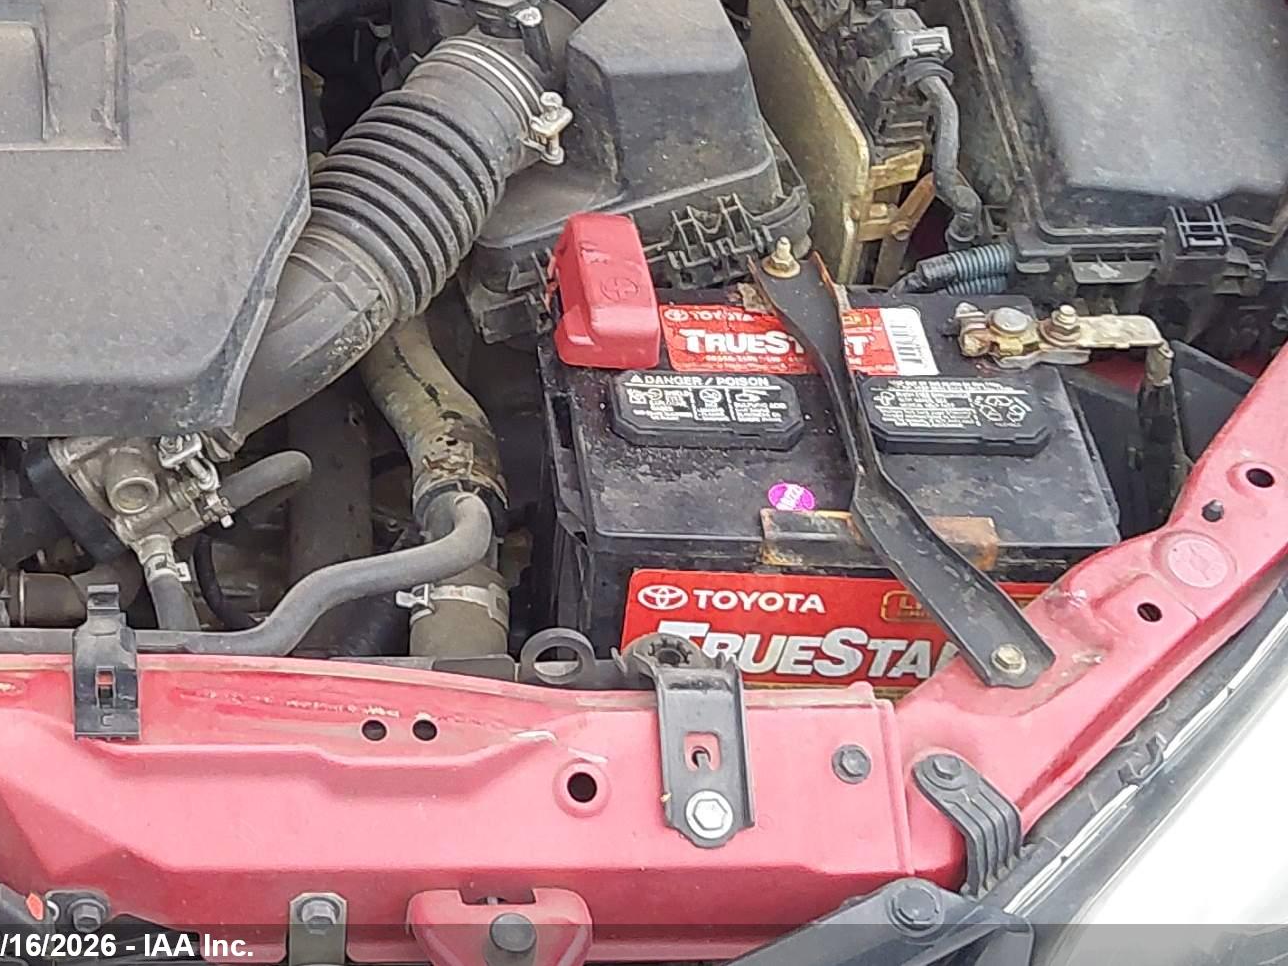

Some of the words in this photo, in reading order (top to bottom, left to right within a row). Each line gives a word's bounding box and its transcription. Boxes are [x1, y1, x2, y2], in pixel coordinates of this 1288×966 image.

[688, 309, 756, 322] TOYOTA
[644, 375, 704, 386] DANGER
[716, 377, 770, 387] POISON
[693, 589, 826, 614] TOYOTA
